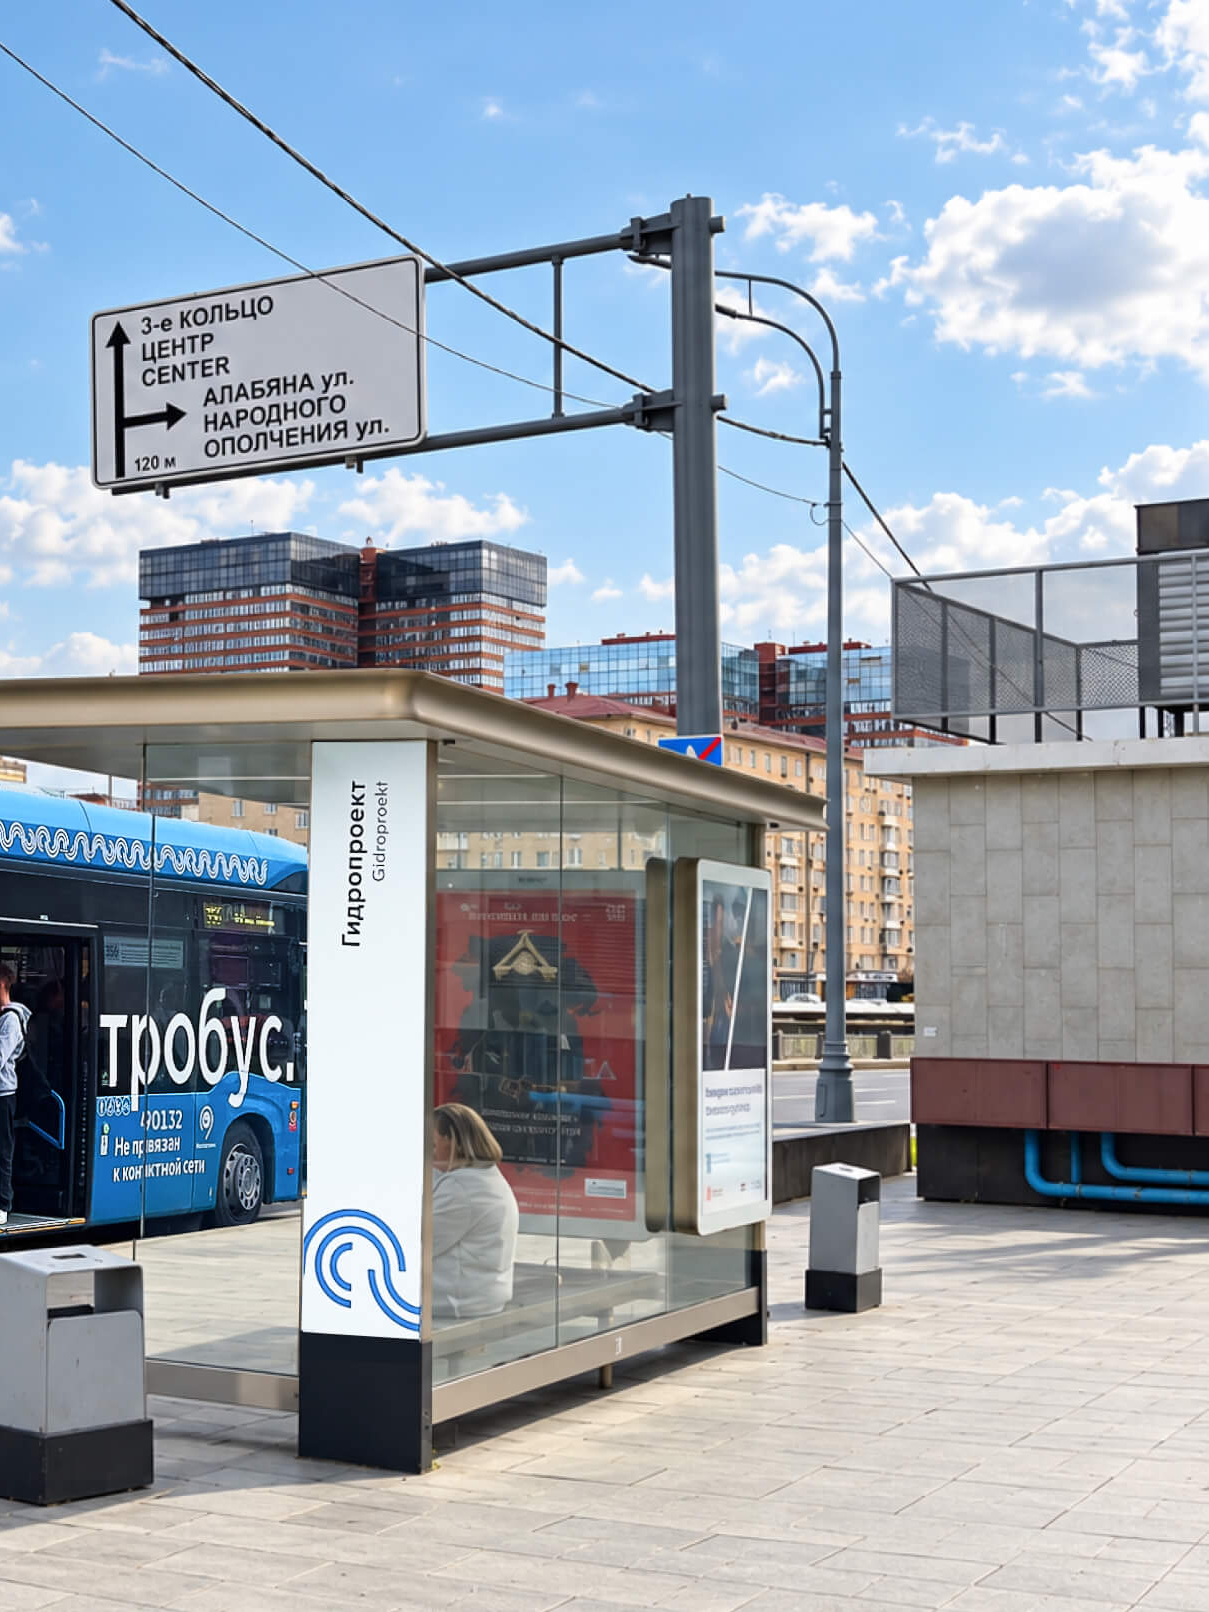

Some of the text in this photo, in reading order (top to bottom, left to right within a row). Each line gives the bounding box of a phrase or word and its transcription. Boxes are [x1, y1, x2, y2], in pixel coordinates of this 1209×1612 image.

[141, 296, 274, 335] 3-е КОЛЬЦО
[142, 333, 215, 364] ЦЕНТР
[142, 356, 230, 386] CENTER
[203, 371, 354, 407] АЛАБЯНА ул.
[204, 395, 346, 433] НАРОДНОГО
[204, 419, 389, 458] ОПОЛЧЕНИЯ ул.
[135, 456, 176, 472] 120 м
[372, 781, 389, 882] Gidroproekt
[341, 780, 368, 947] Гидропроект
[114, 1135, 181, 1159] Не првязан
[113, 1167, 121, 1183] к
[183, 1159, 205, 1174] сети
